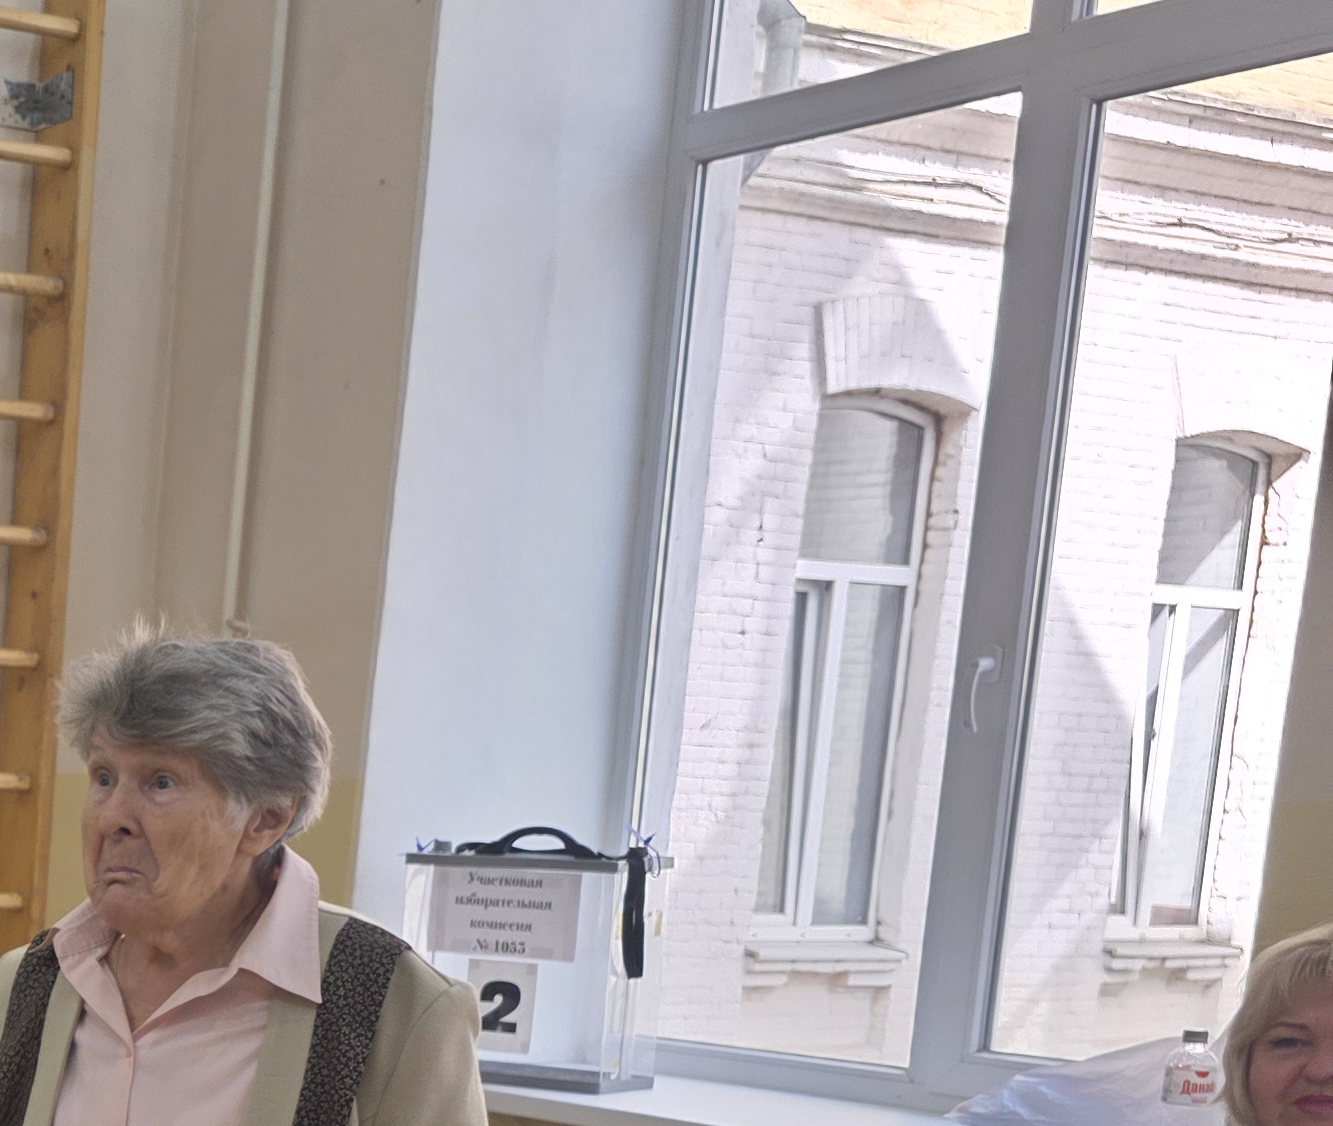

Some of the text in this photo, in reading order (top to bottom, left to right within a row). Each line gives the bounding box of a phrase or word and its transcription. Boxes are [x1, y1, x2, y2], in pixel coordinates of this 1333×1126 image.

[468, 871, 543, 889] Участковая
[455, 892, 552, 911] избирательная
[470, 919, 532, 932] комиссия
[480, 981, 521, 1034] 2
